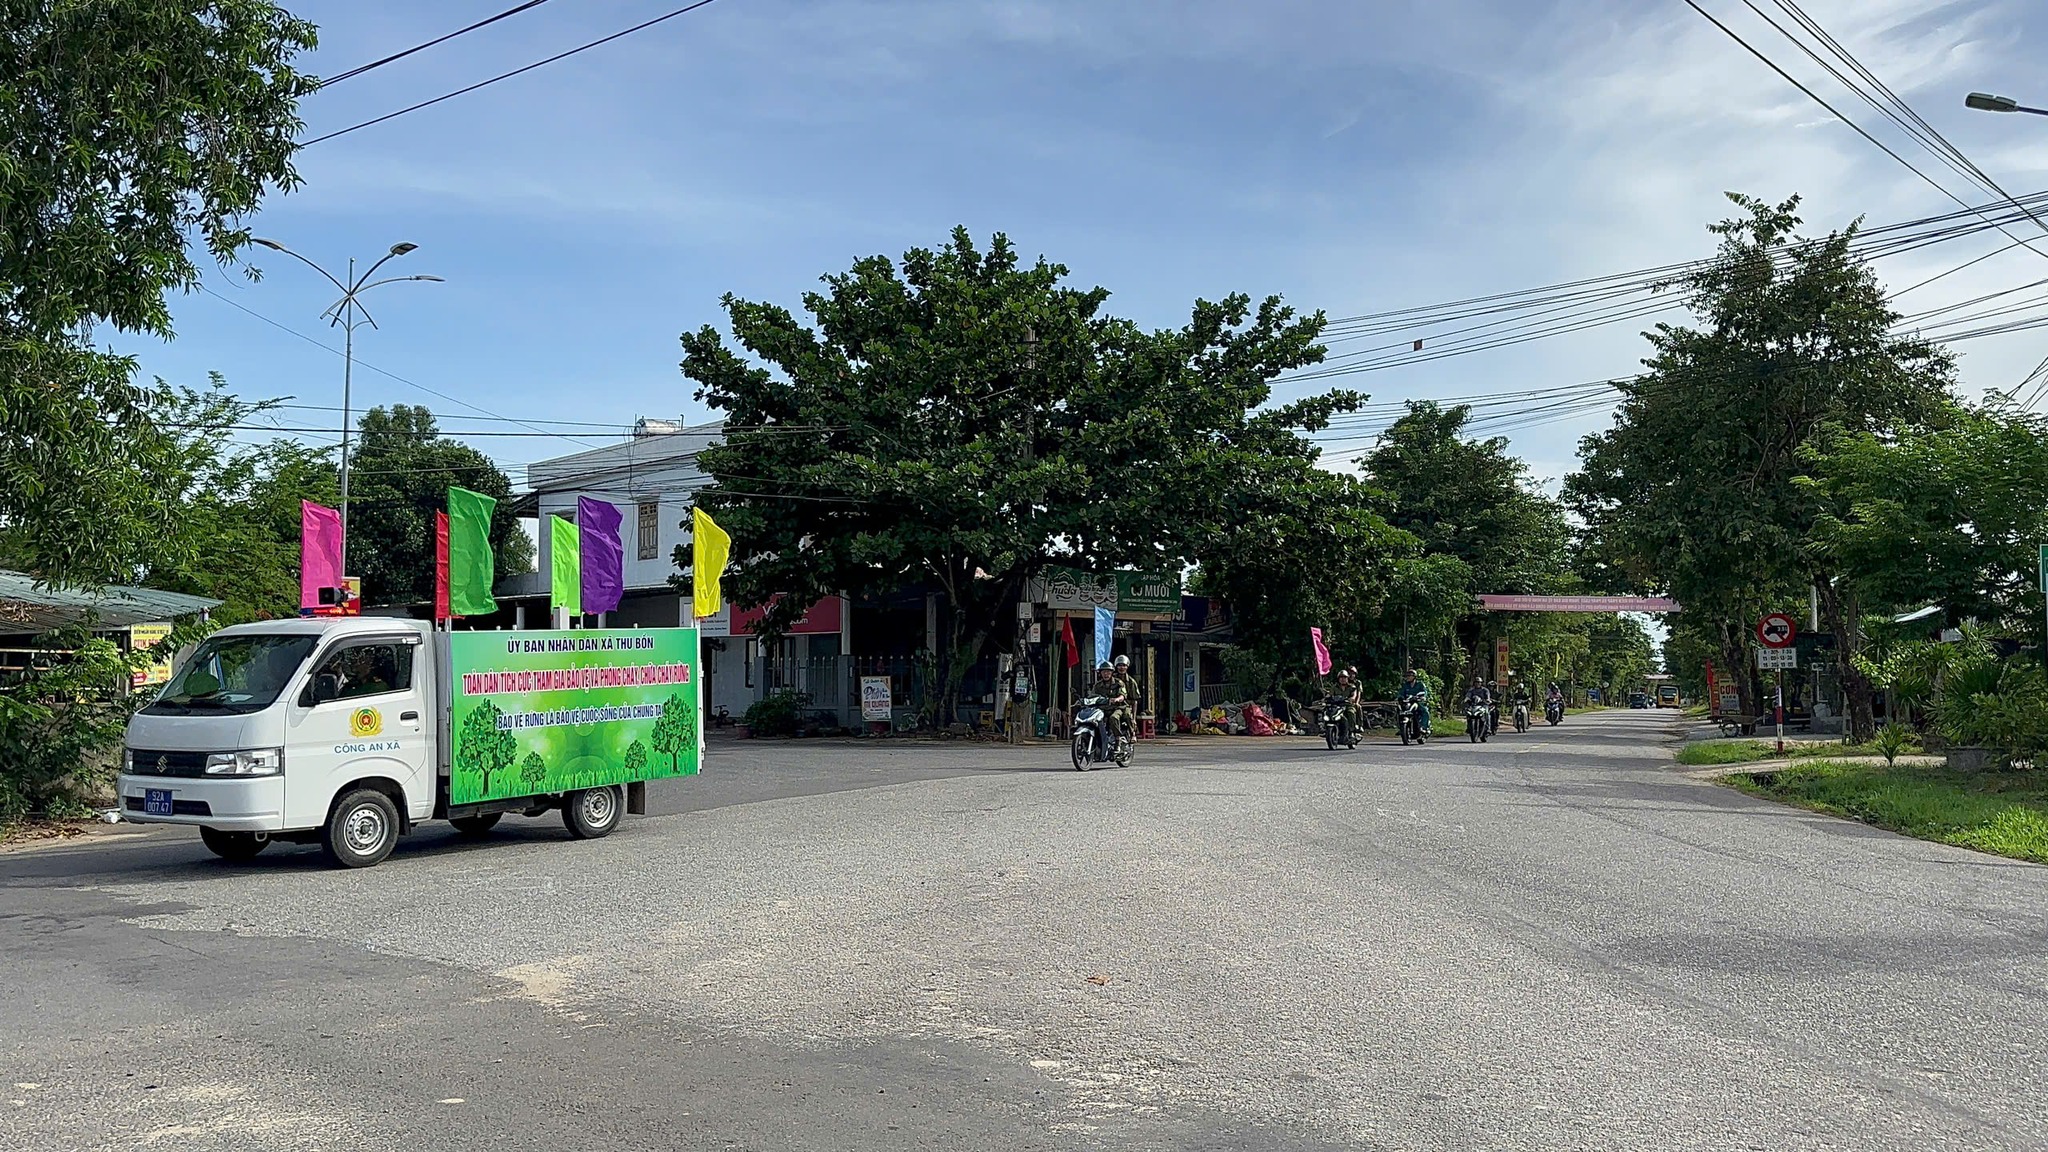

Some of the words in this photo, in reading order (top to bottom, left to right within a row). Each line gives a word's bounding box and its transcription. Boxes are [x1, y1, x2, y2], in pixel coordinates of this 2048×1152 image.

[508, 636, 520, 653] ỦY
[524, 640, 544, 652] BAN
[548, 637, 576, 652] NHÂN
[578, 636, 598, 650] DÂN
[601, 636, 613, 650] XÃ
[616, 638, 632, 650] THU
[463, 669, 482, 694] TOÀN
[484, 668, 498, 693] DÂN
[500, 667, 516, 692] TÍCH
[518, 669, 532, 696] CỰC
[534, 670, 552, 690] THAM
[554, 670, 566, 689] GIA
[566, 662, 580, 688] BẢO
[580, 664, 590, 693] VỆ
[600, 662, 622, 686] PHÒNG
[657, 661, 672, 684] CHÁY
[498, 710, 512, 729] BẢO
[514, 712, 523, 731] VỆ
[525, 710, 544, 727] RỪNG
[546, 708, 554, 725] LÀ
[556, 706, 570, 724] BẢO
[572, 706, 580, 727] VỆ
[581, 706, 598, 726] CUỘC
[600, 702, 618, 721] SỐNG
[618, 702, 632, 719] CỦA
[633, 702, 654, 718] CHÚNG
[334, 743, 366, 754] CÔNG
[369, 743, 383, 751] AN
[386, 740, 400, 750] XÃ
[152, 790, 164, 801] 92A
